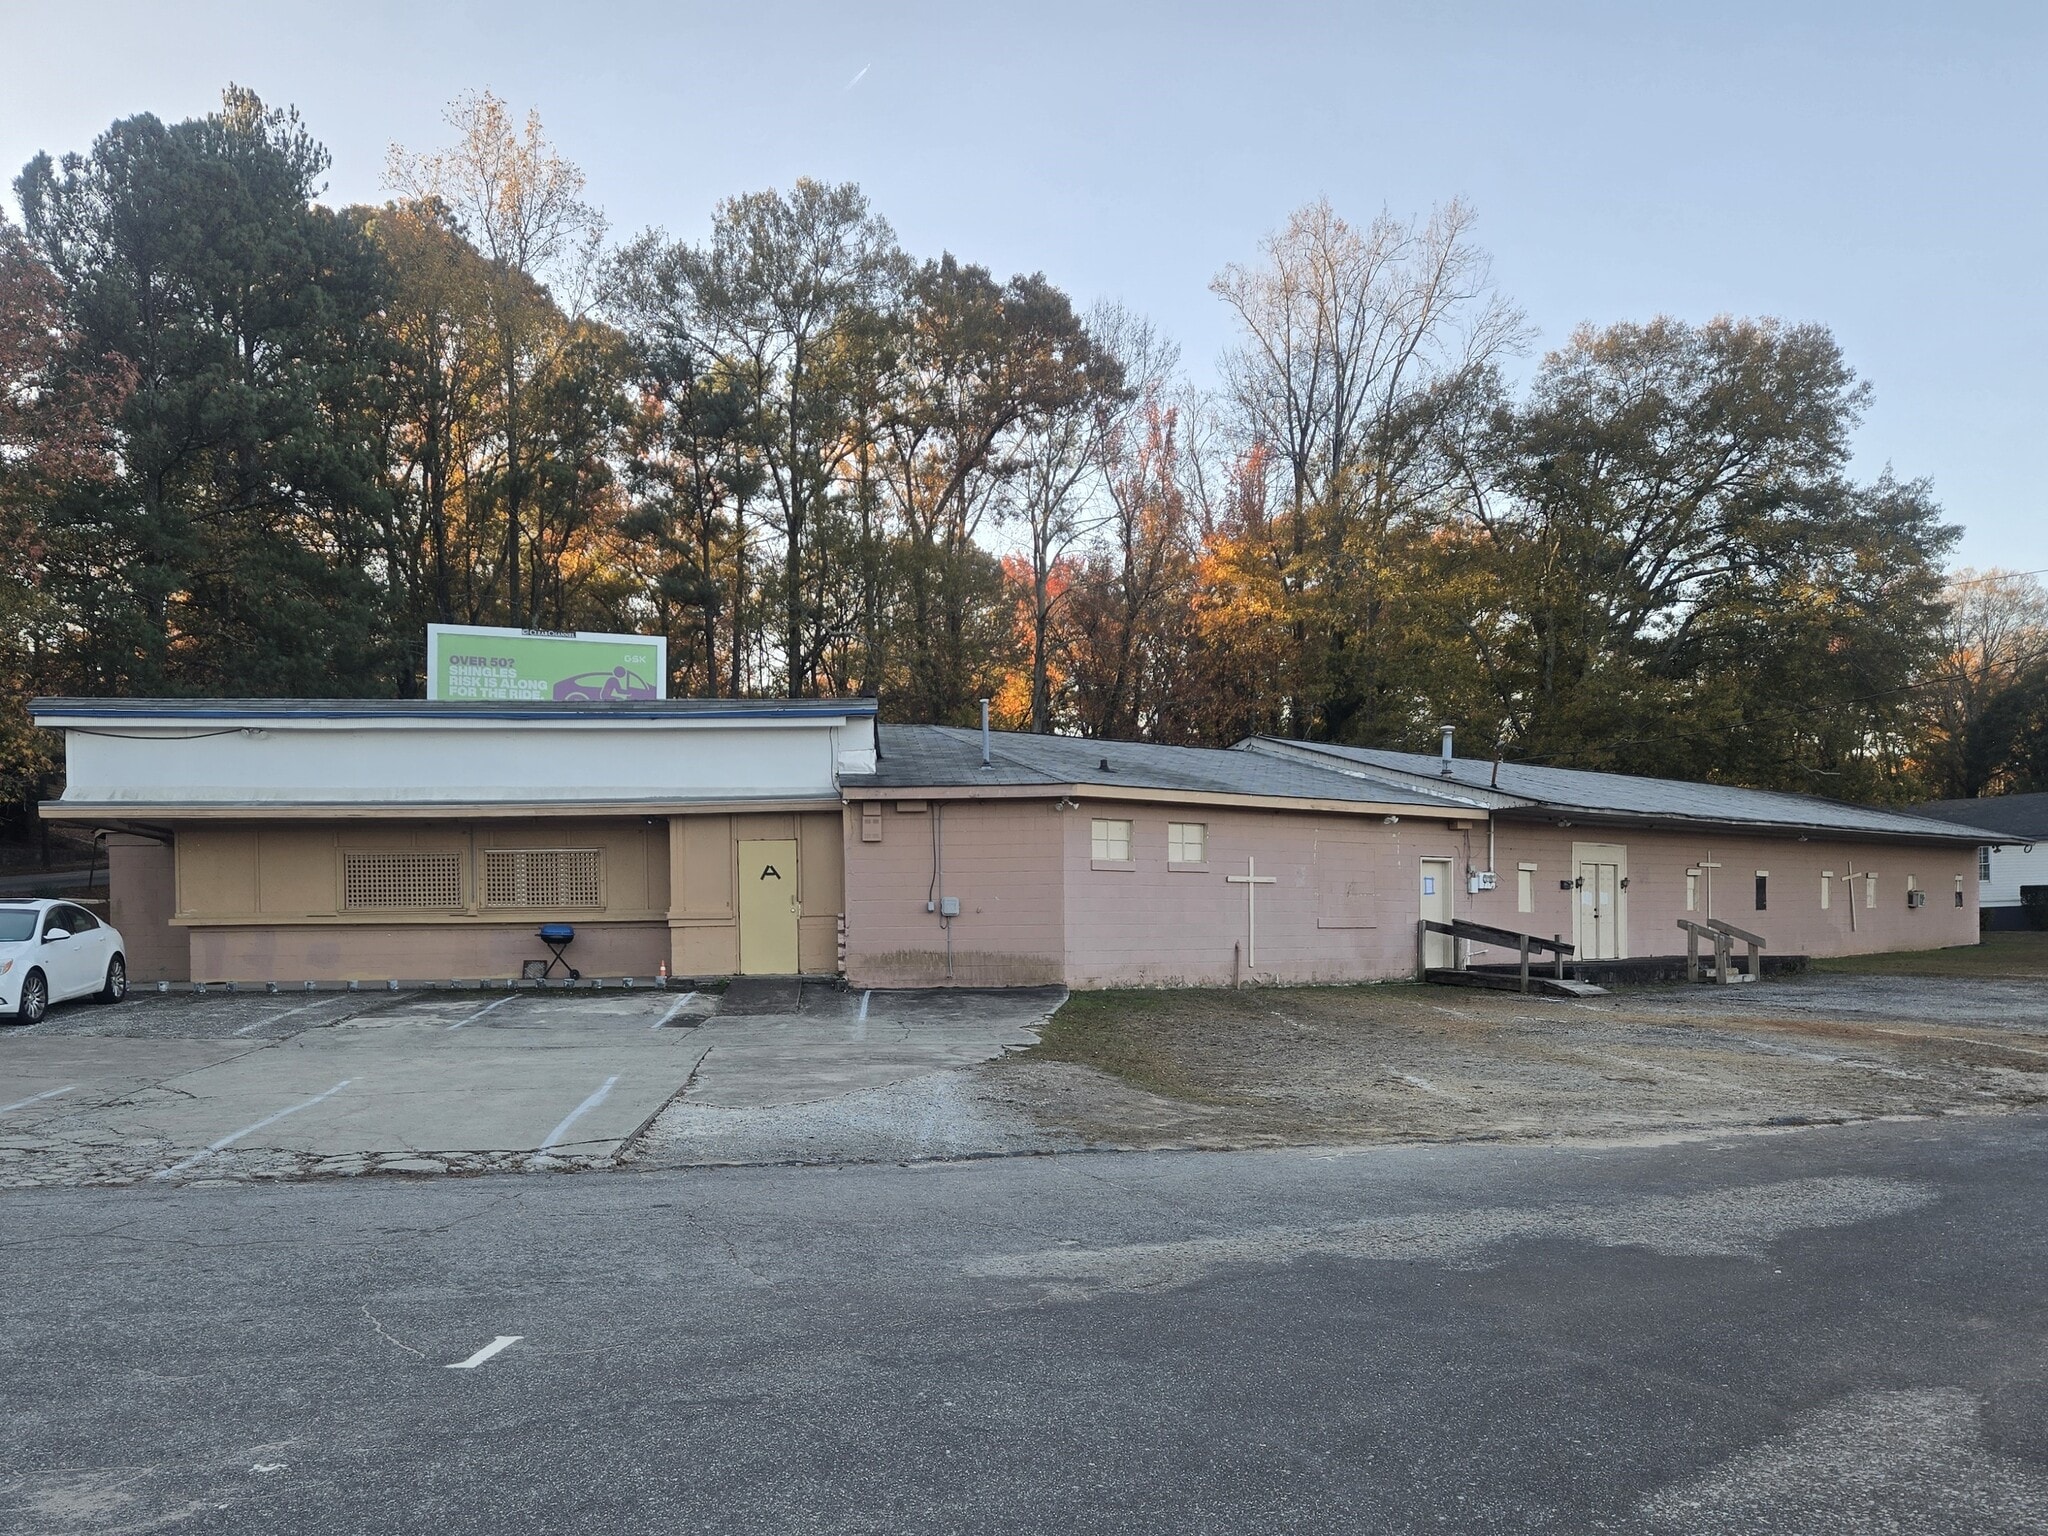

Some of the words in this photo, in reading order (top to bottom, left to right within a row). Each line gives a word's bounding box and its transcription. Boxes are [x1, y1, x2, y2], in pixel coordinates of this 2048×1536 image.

[449, 655, 487, 666] OVER
[490, 657, 515, 668] 50?
[624, 655, 646, 663] GSK
[449, 665, 517, 678] SHINGLES
[449, 676, 481, 687] RISK
[484, 678, 497, 687] IS
[500, 679, 548, 690] ALONG
[449, 686, 477, 697] FOR
[480, 688, 506, 699] THE
[509, 689, 544, 700] RIDE.
[760, 865, 781, 880] A
